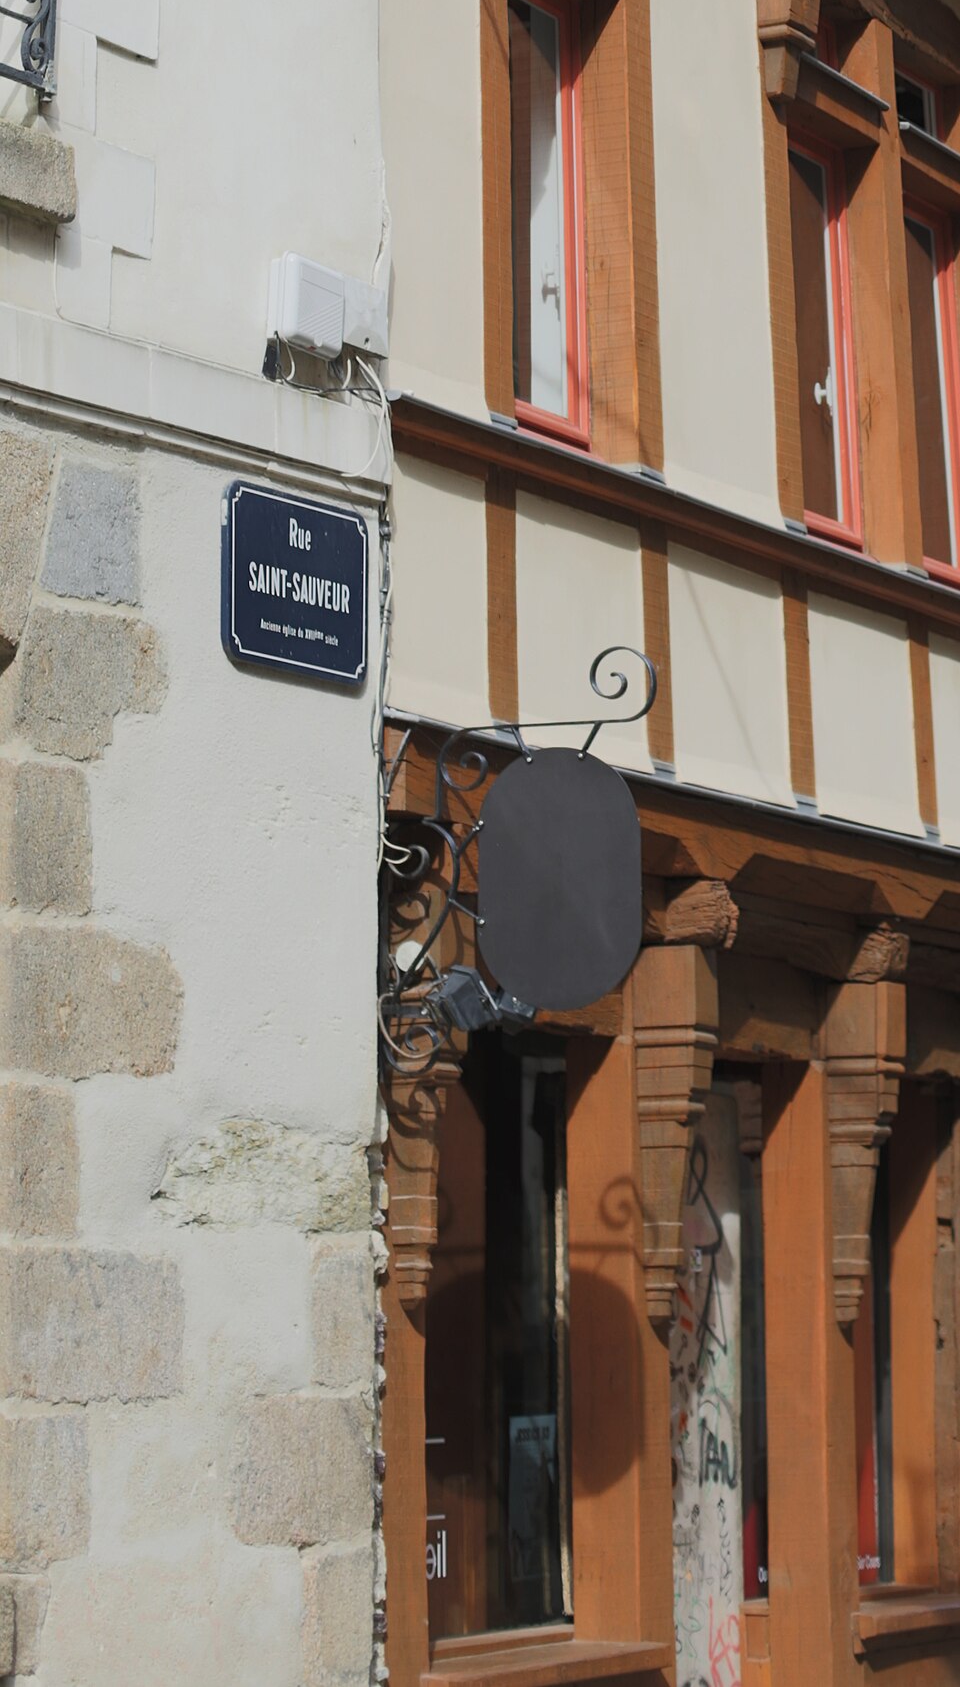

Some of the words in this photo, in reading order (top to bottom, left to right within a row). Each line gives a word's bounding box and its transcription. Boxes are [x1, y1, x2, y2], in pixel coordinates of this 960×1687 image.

[289, 517, 311, 551] Rue
[248, 561, 351, 614] SAINT-SAUVEUR
[260, 618, 281, 634] Ancienne
[282, 624, 297, 638] église
[297, 626, 304, 639] du
[324, 634, 339, 647] siècle
